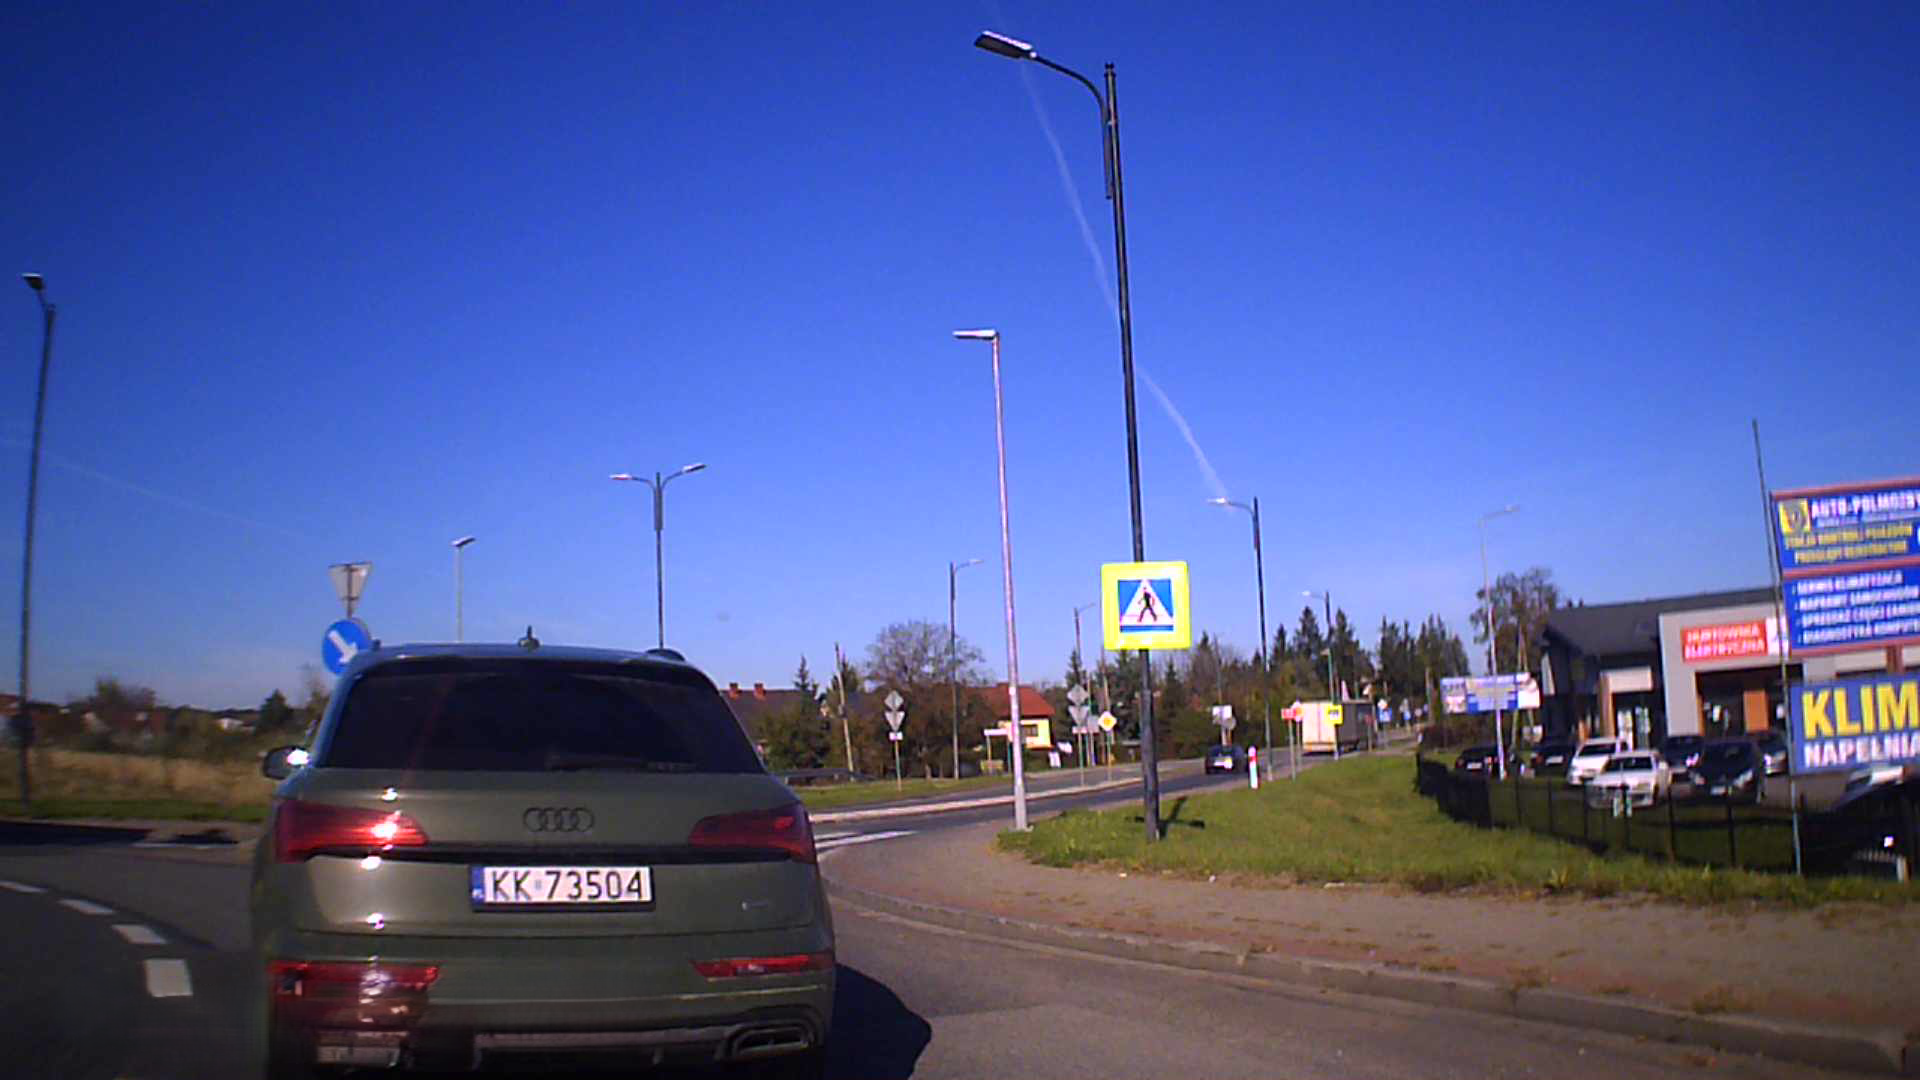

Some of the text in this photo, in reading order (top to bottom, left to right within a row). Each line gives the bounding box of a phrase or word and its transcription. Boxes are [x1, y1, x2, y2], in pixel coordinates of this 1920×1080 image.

[1802, 680, 1920, 740] KLIM
[492, 869, 643, 901] KK 73504
